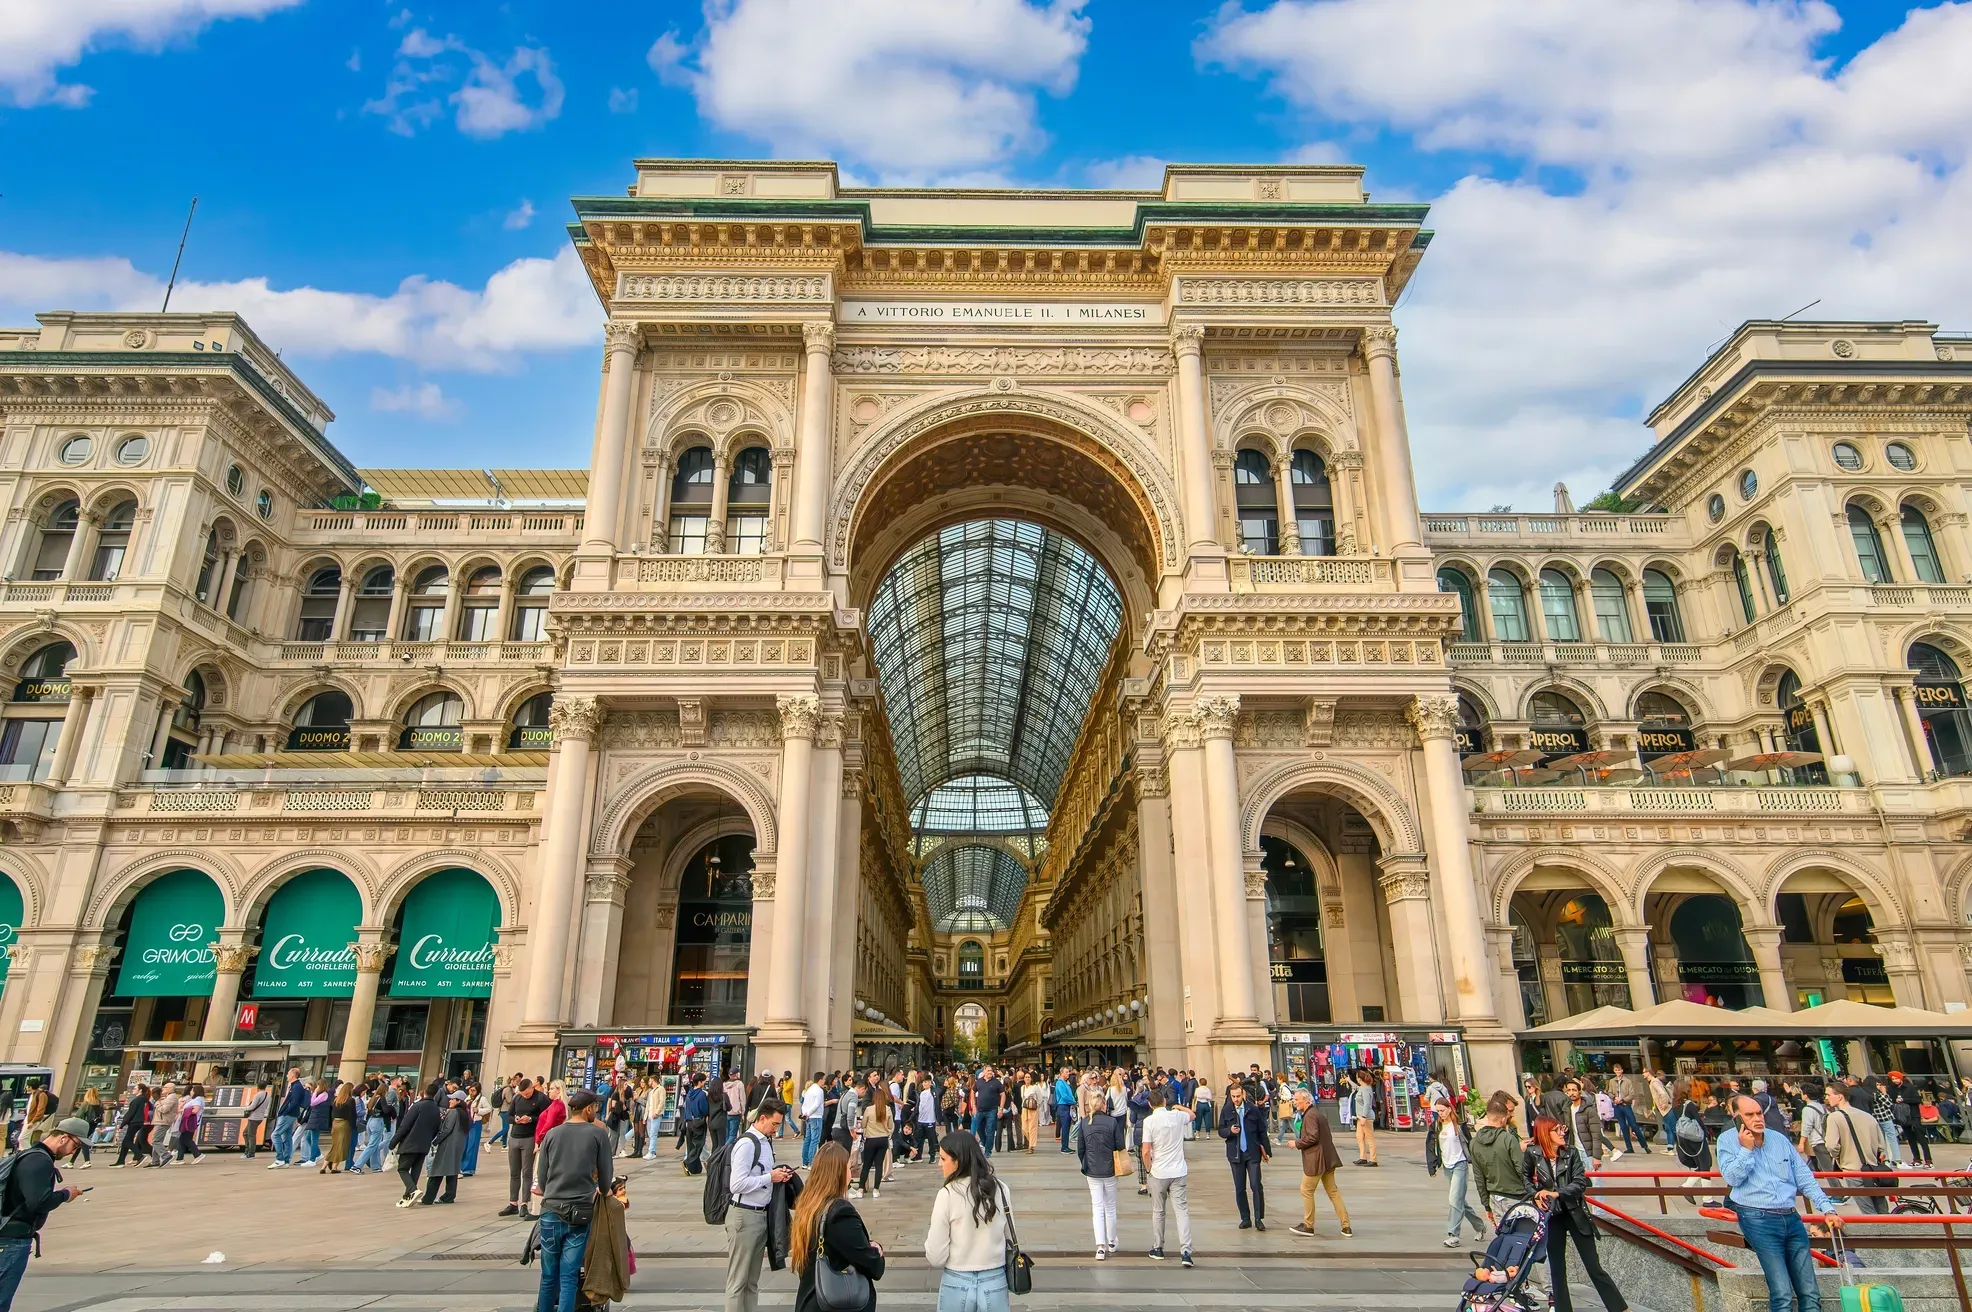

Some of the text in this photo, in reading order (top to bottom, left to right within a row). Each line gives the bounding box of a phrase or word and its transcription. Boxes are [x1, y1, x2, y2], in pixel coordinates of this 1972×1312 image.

[858, 307, 1146, 318] A VITTORIO EMANUELE II. I MILANESI
[26, 684, 71, 695] DUOMO
[1791, 709, 1812, 728] APE
[300, 732, 340, 743] DUOMO
[410, 732, 451, 742] DUOMO
[521, 731, 553, 741] DUOM
[693, 912, 753, 927] CAMPARIN
[409, 933, 495, 970] Currado
[305, 963, 355, 971] GIOIELLERIE
[444, 963, 492, 971] GIOIELLERIE
[1270, 964, 1293, 977] otta
[1687, 966, 1723, 974] MERCATO
[1734, 966, 1758, 974] DUOM
[1855, 966, 1883, 976] TIFFA
[257, 980, 288, 988] MILANO
[298, 980, 313, 988] ASTI
[240, 1008, 254, 1024] M
